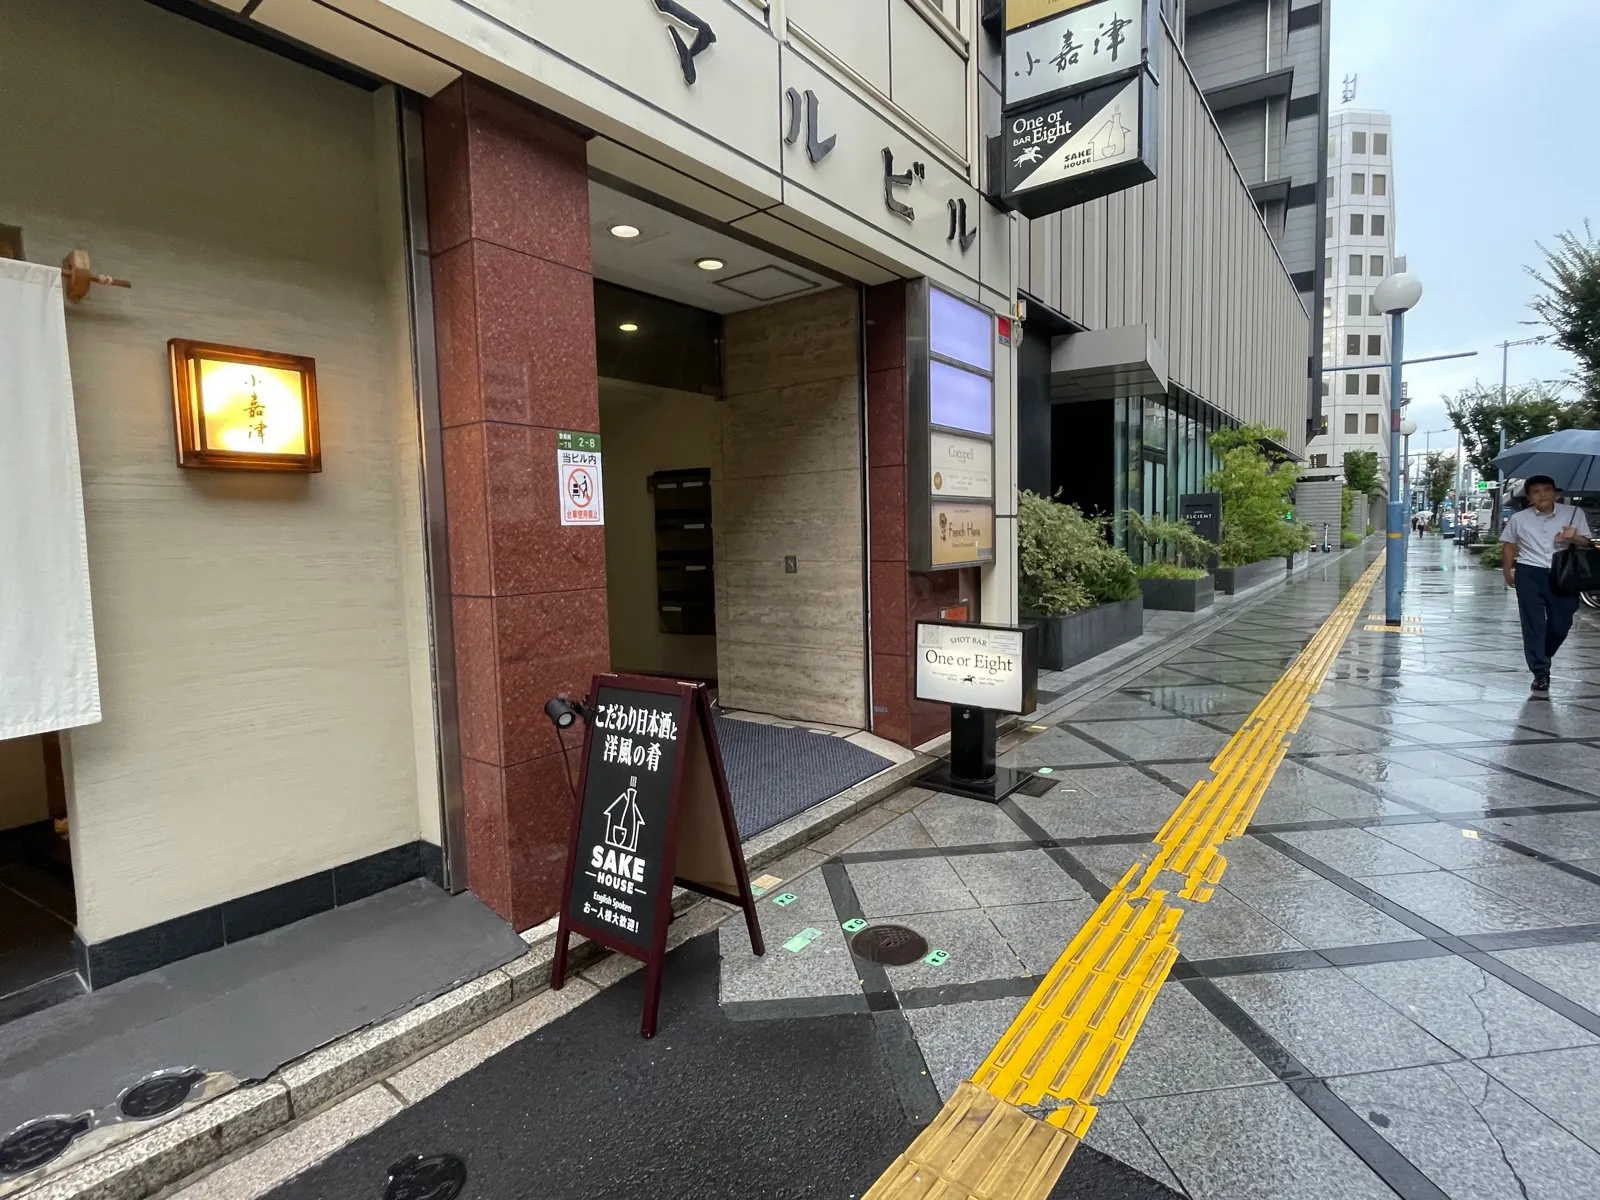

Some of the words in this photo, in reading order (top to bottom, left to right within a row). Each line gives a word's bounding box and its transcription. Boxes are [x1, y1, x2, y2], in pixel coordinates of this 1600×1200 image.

[1014, 11, 1133, 77] 小嘉津
[651, 0, 978, 253] マルビル
[1012, 116, 1044, 134] One
[1047, 110, 1064, 123] or
[1012, 135, 1031, 147] BAR
[1031, 120, 1072, 144] Eight
[1063, 157, 1092, 170] HOUSE
[1064, 148, 1092, 162] SAKE
[243, 374, 268, 444] 小嘉津
[578, 437, 596, 448] 2-8
[562, 452, 597, 465] 当ビル内
[949, 636, 971, 645] SHOT
[971, 637, 987, 647] BAR
[925, 649, 954, 666] One
[956, 656, 971, 667] or
[974, 654, 1013, 675] Eight
[595, 703, 678, 741] こだわり日本酒と
[603, 734, 662, 772] 洋風の肴
[590, 845, 646, 883] SAKE
[596, 872, 635, 895] HOUSE
[593, 890, 612, 906] English
[611, 897, 632, 913] Spoken
[583, 901, 640, 934] お一人様大歓迎!
[936, 950, 947, 958] G
